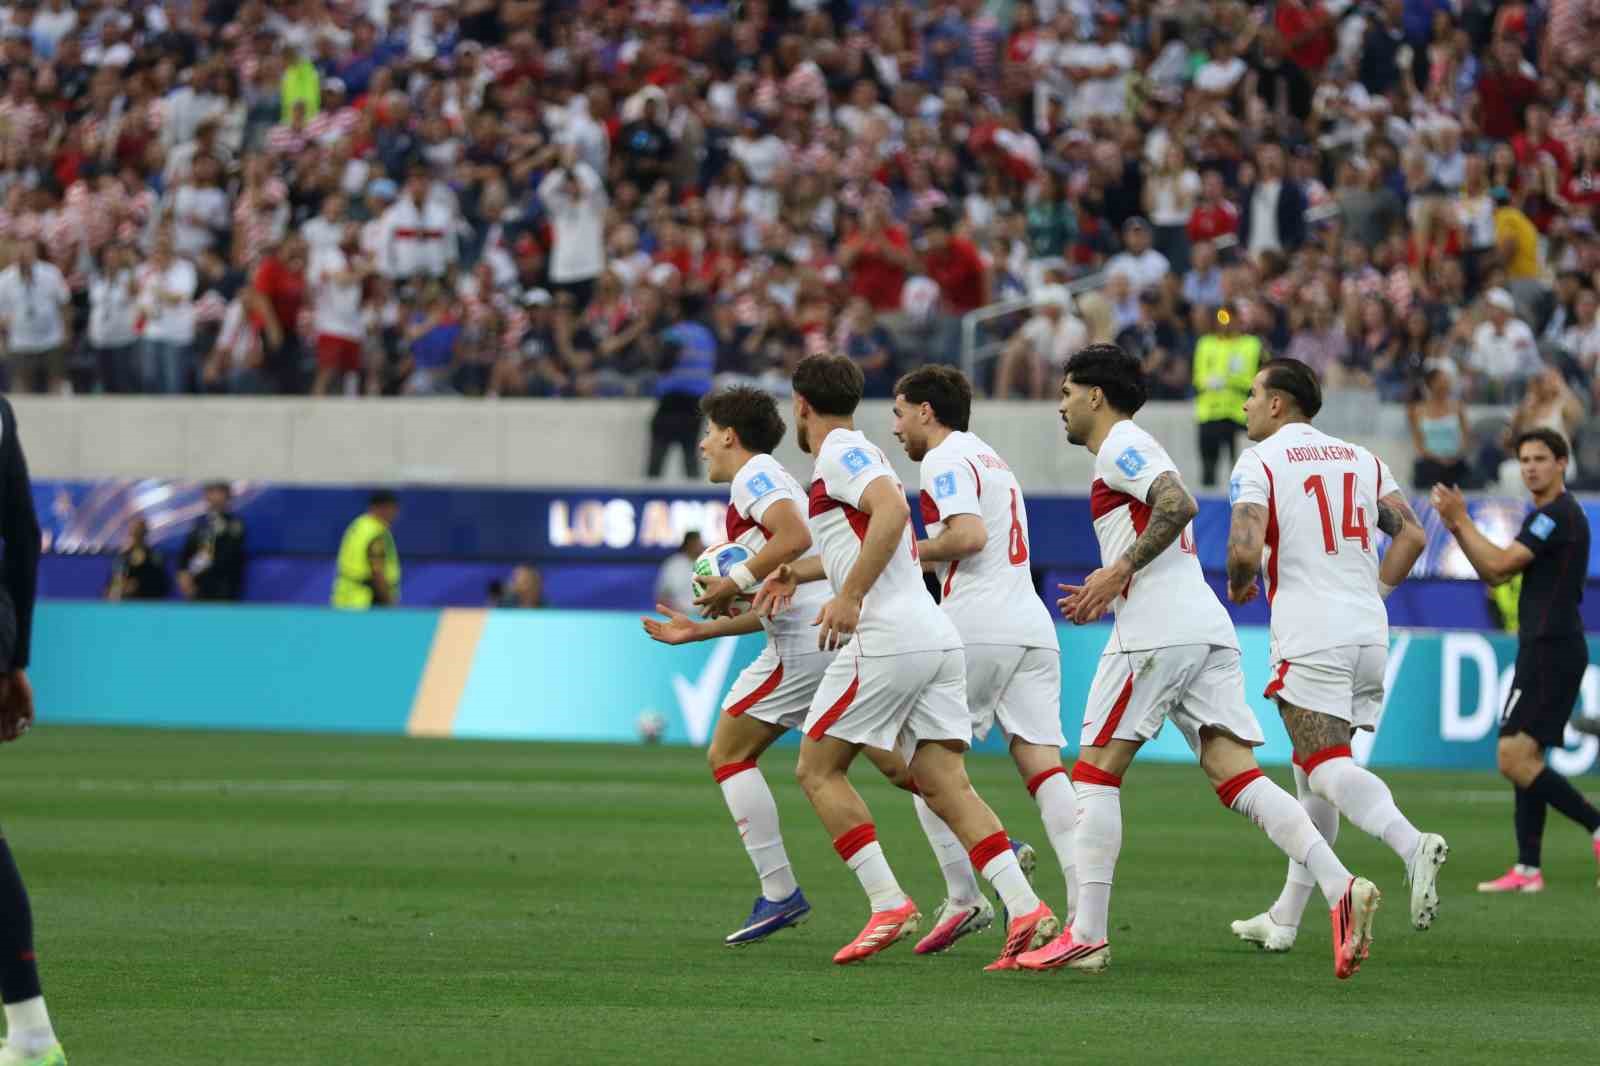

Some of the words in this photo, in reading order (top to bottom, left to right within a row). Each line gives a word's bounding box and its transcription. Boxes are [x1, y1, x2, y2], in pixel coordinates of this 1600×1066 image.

[549, 498, 636, 548] LOS
[1008, 487, 1028, 567] 6
[1303, 472, 1371, 555] 14
